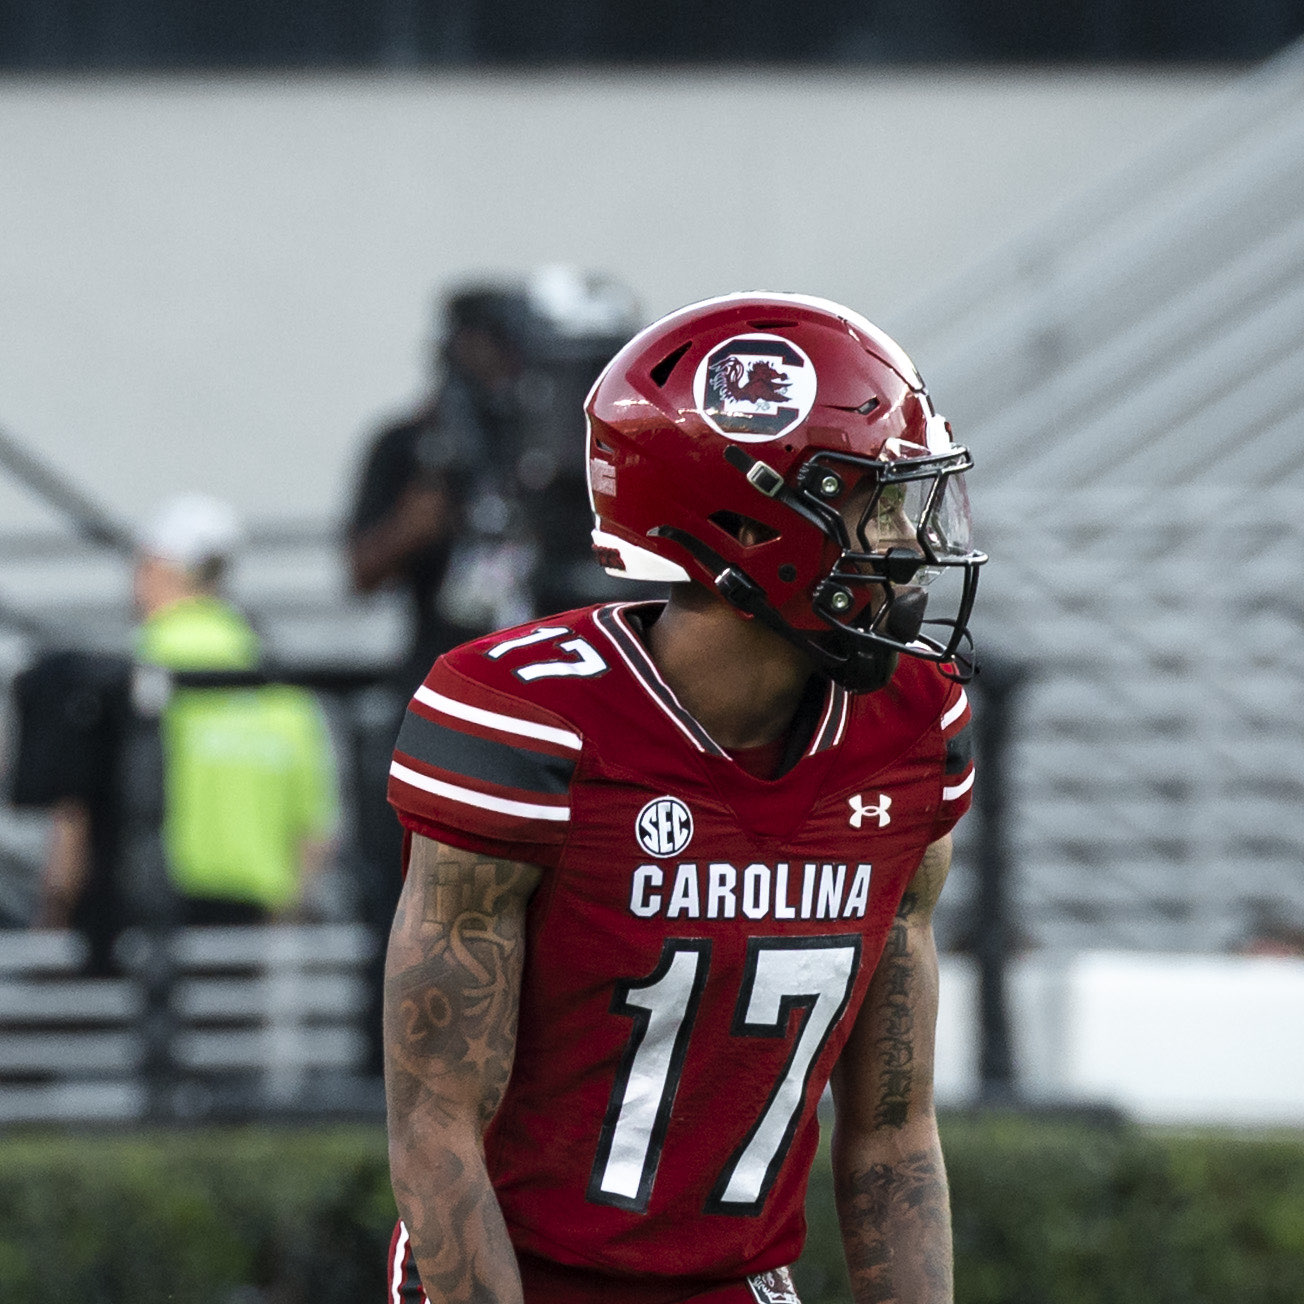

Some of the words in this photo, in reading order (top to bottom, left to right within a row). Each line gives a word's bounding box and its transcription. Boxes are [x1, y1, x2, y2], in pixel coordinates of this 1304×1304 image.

[487, 623, 611, 684] 17
[640, 801, 689, 854] SEC
[629, 861, 873, 921] CAROLINA
[587, 934, 862, 1217] 17
